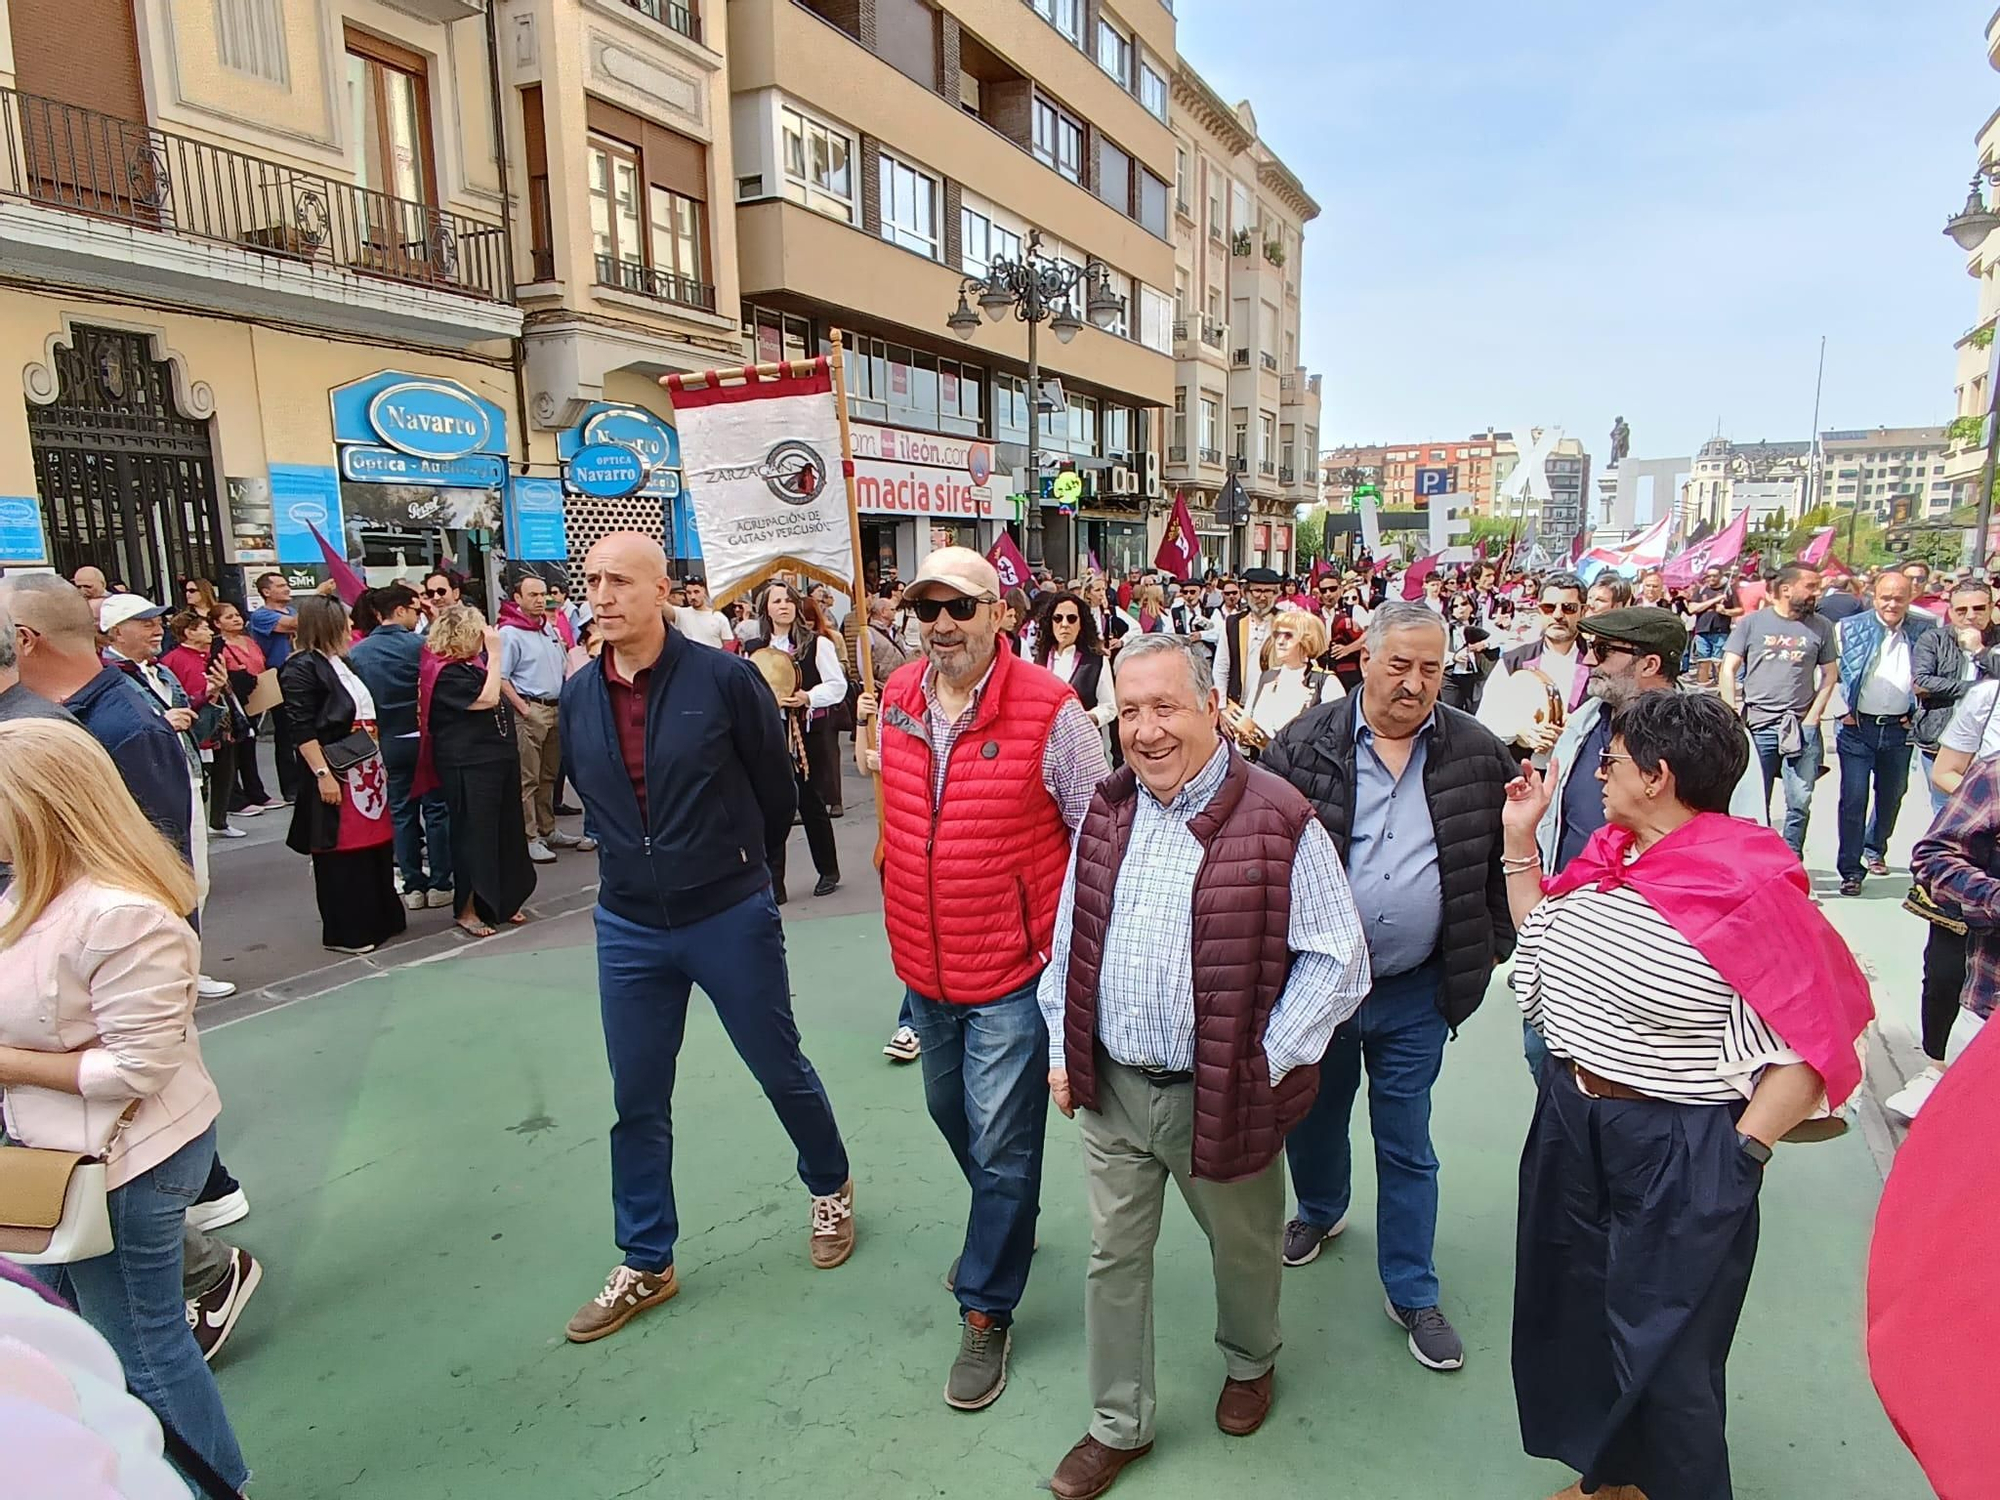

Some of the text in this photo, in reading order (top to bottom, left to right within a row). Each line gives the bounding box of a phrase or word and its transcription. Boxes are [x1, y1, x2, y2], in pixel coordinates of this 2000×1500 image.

[387, 405, 476, 436] Navarro
[596, 429, 659, 454] Nrro
[596, 456, 632, 466] OPTICA
[576, 467, 636, 482] Navarro
[1423, 472, 1439, 494] P
[856, 471, 930, 513] macia
[736, 510, 821, 532] AGRUPACIÓN DE
[728, 530, 767, 546] GAITAS
[289, 576, 316, 587] SMH
